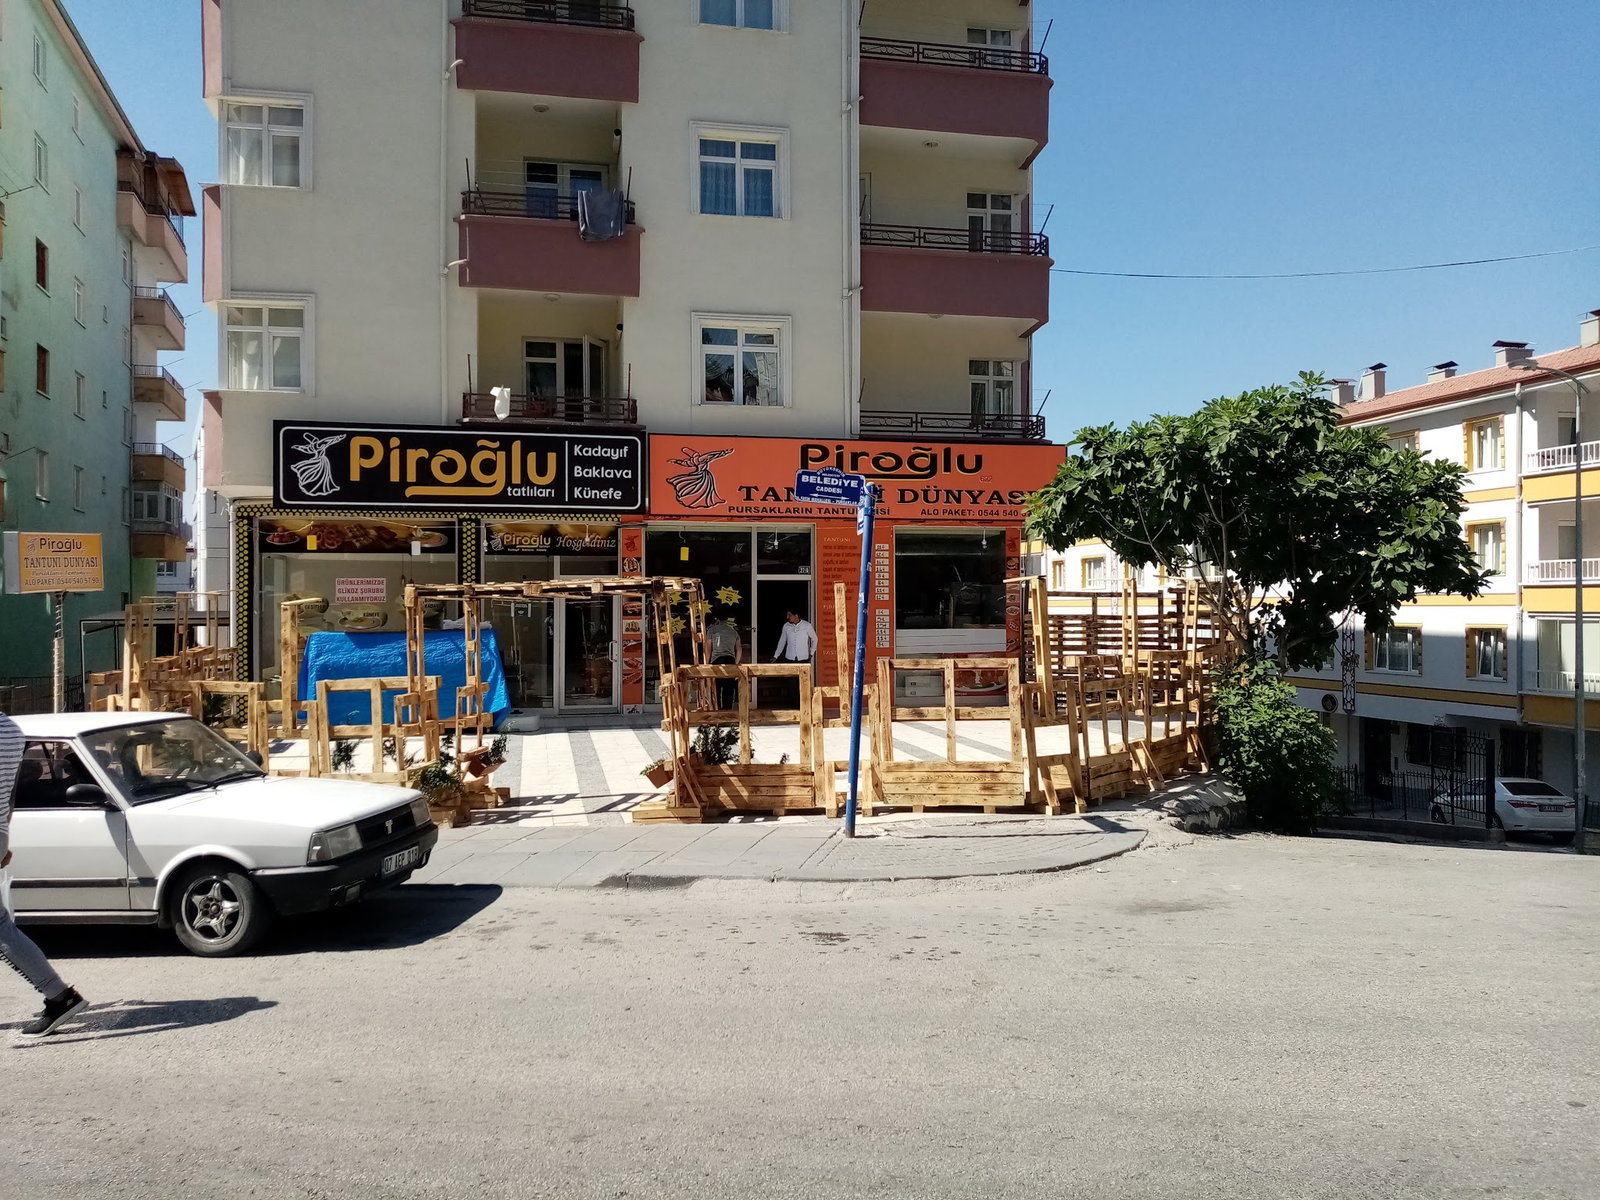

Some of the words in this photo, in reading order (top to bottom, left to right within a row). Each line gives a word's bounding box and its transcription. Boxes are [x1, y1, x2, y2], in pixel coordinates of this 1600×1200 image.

[573, 444, 629, 460] Kadayıf
[350, 436, 557, 498] Piroğlu
[799, 443, 984, 481] Piroğlu
[573, 465, 632, 479] Baklava
[506, 486, 555, 498] tatlıları
[573, 486, 622, 499] Künefe
[728, 505, 813, 515] PURSAKLARIN
[920, 508, 939, 516] ALO
[942, 508, 976, 517] PAKET:
[978, 509, 999, 517] 0544
[1002, 509, 1019, 517] 540
[40, 537, 82, 553] Piroğlu
[384, 858, 392, 872] 07
